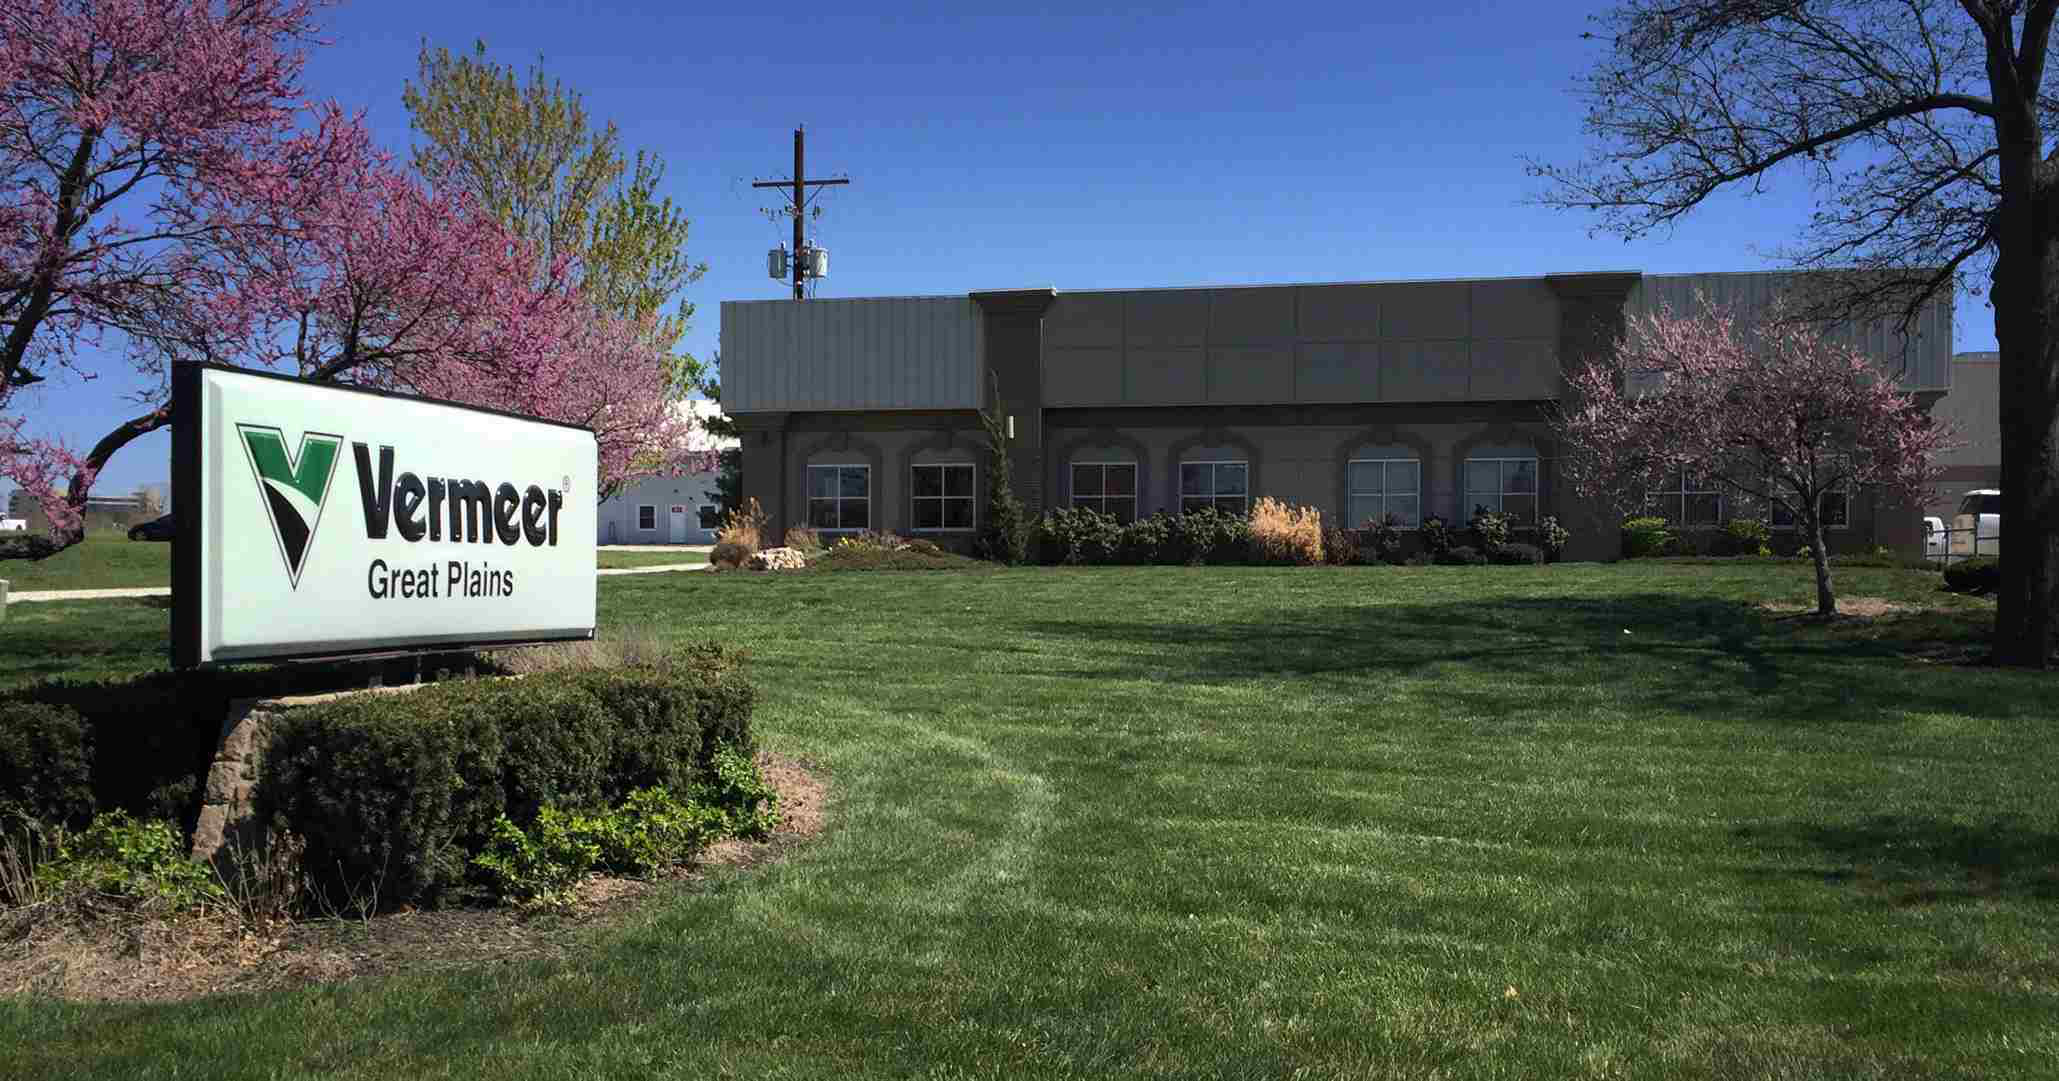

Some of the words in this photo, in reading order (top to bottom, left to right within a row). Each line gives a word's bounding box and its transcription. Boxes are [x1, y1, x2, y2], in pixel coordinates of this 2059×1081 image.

[352, 441, 562, 547] Vermeer
[368, 559, 438, 599] Great
[447, 561, 513, 598] Plains
